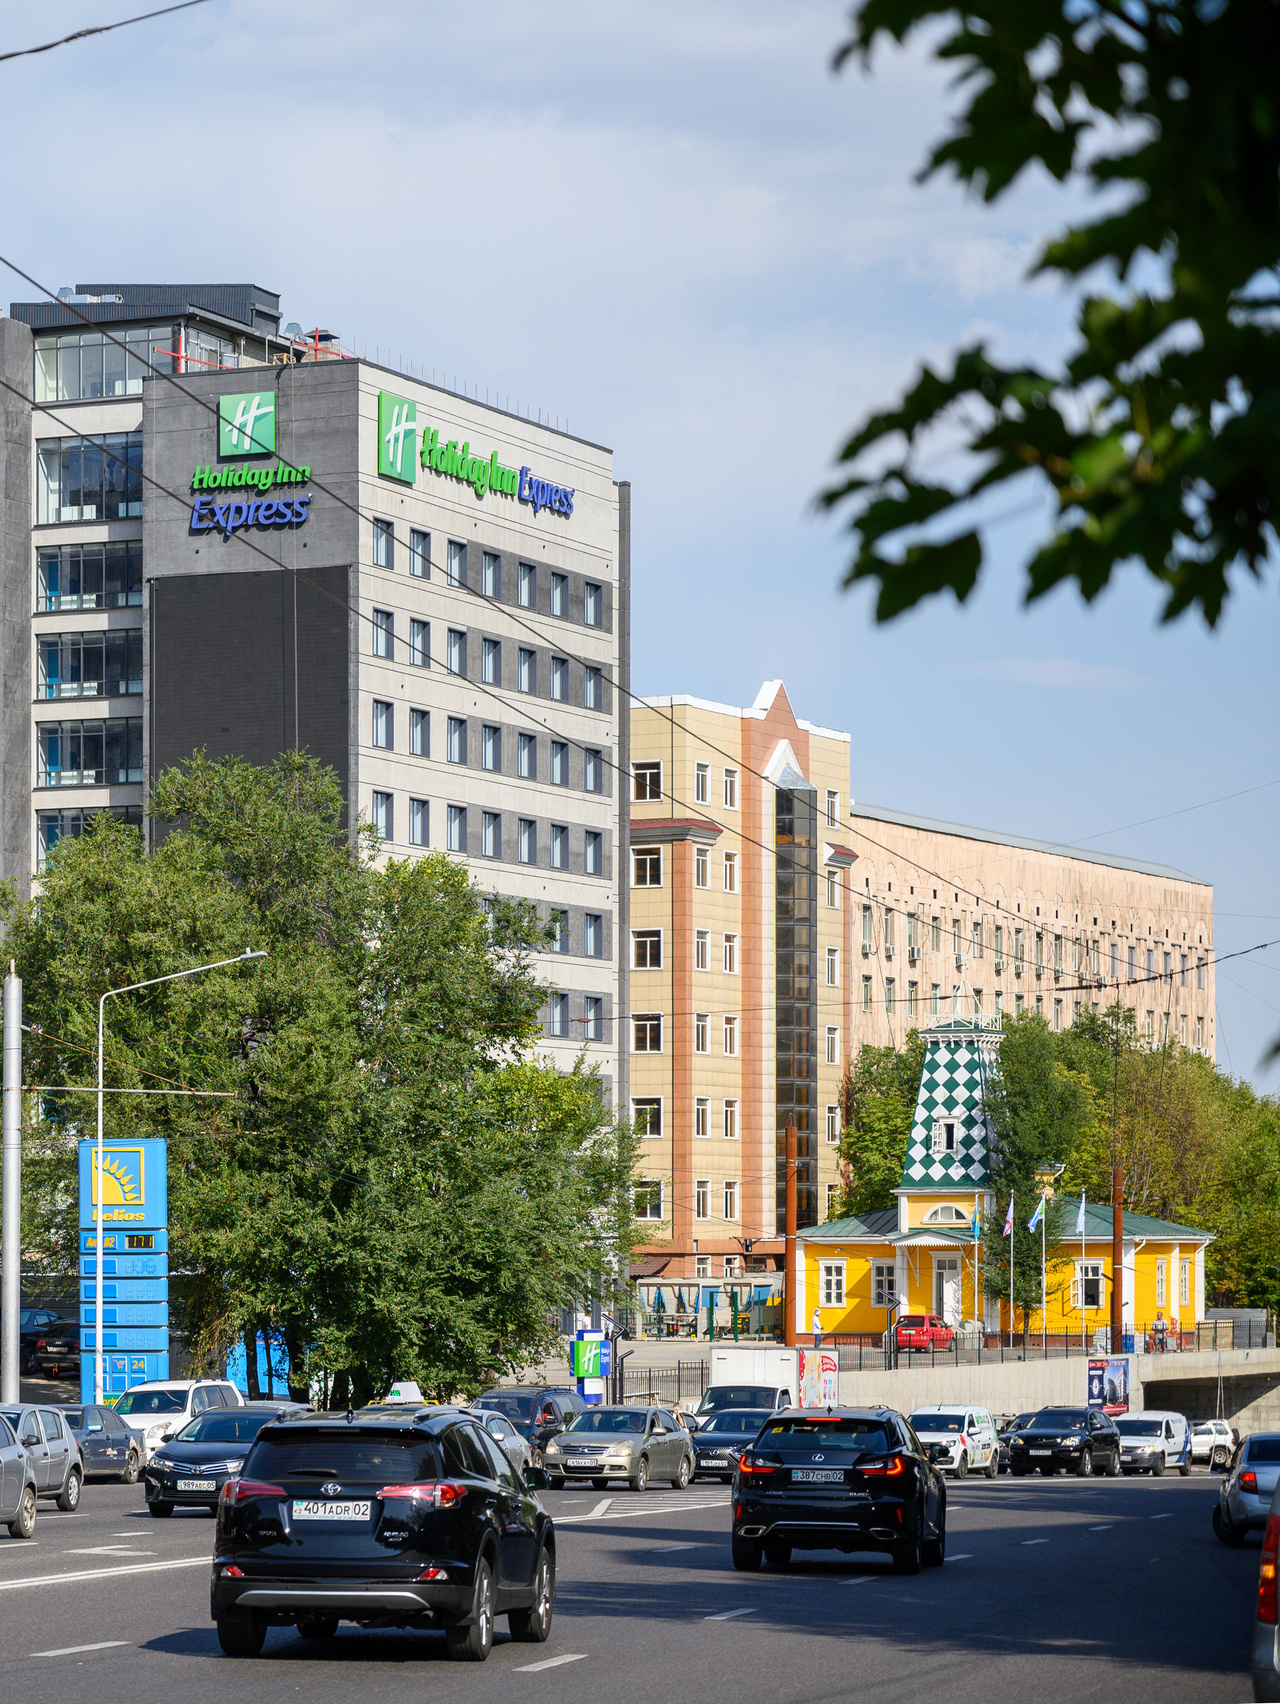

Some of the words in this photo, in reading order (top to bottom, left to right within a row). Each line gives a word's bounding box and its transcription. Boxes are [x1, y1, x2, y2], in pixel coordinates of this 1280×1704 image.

[192, 462, 275, 490] Holiday
[276, 460, 311, 483] Inn
[420, 426, 490, 496] Holiday
[490, 450, 519, 496] Inn
[520, 465, 575, 515] Express
[191, 496, 310, 536] Express
[132, 1360, 144, 1369] 24
[832, 1471, 843, 1480] 02
[304, 1502, 350, 1515] 401ADR
[353, 1503, 369, 1515] 02
